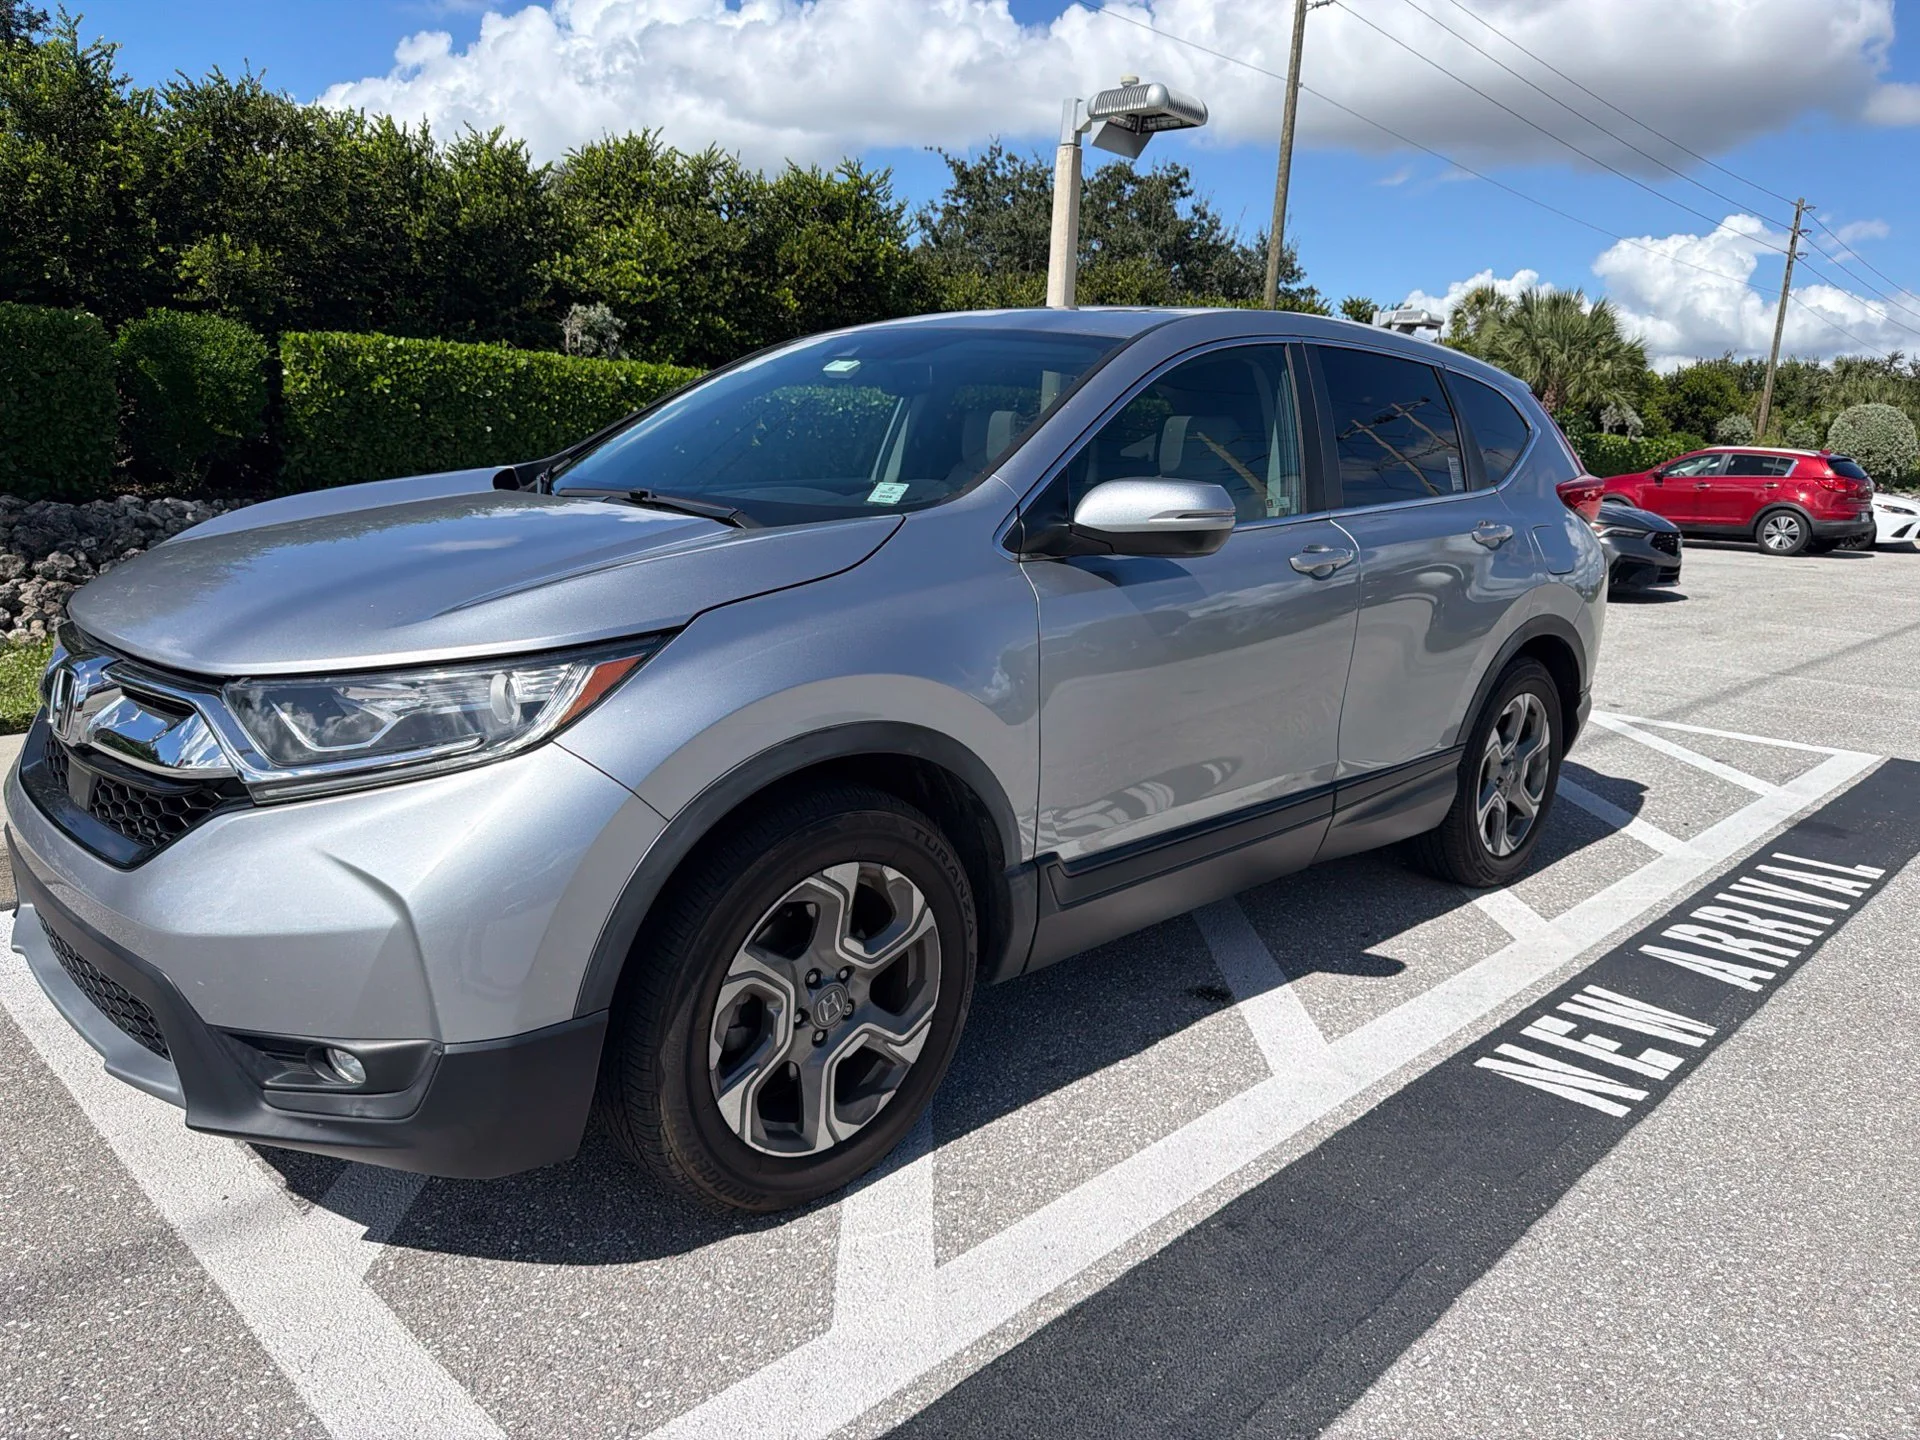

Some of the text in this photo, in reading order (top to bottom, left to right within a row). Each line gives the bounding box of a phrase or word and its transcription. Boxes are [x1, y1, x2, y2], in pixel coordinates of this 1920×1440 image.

[912, 826, 974, 938] TURANZA
[1474, 852, 1886, 1118] NEW ARRIVAL
